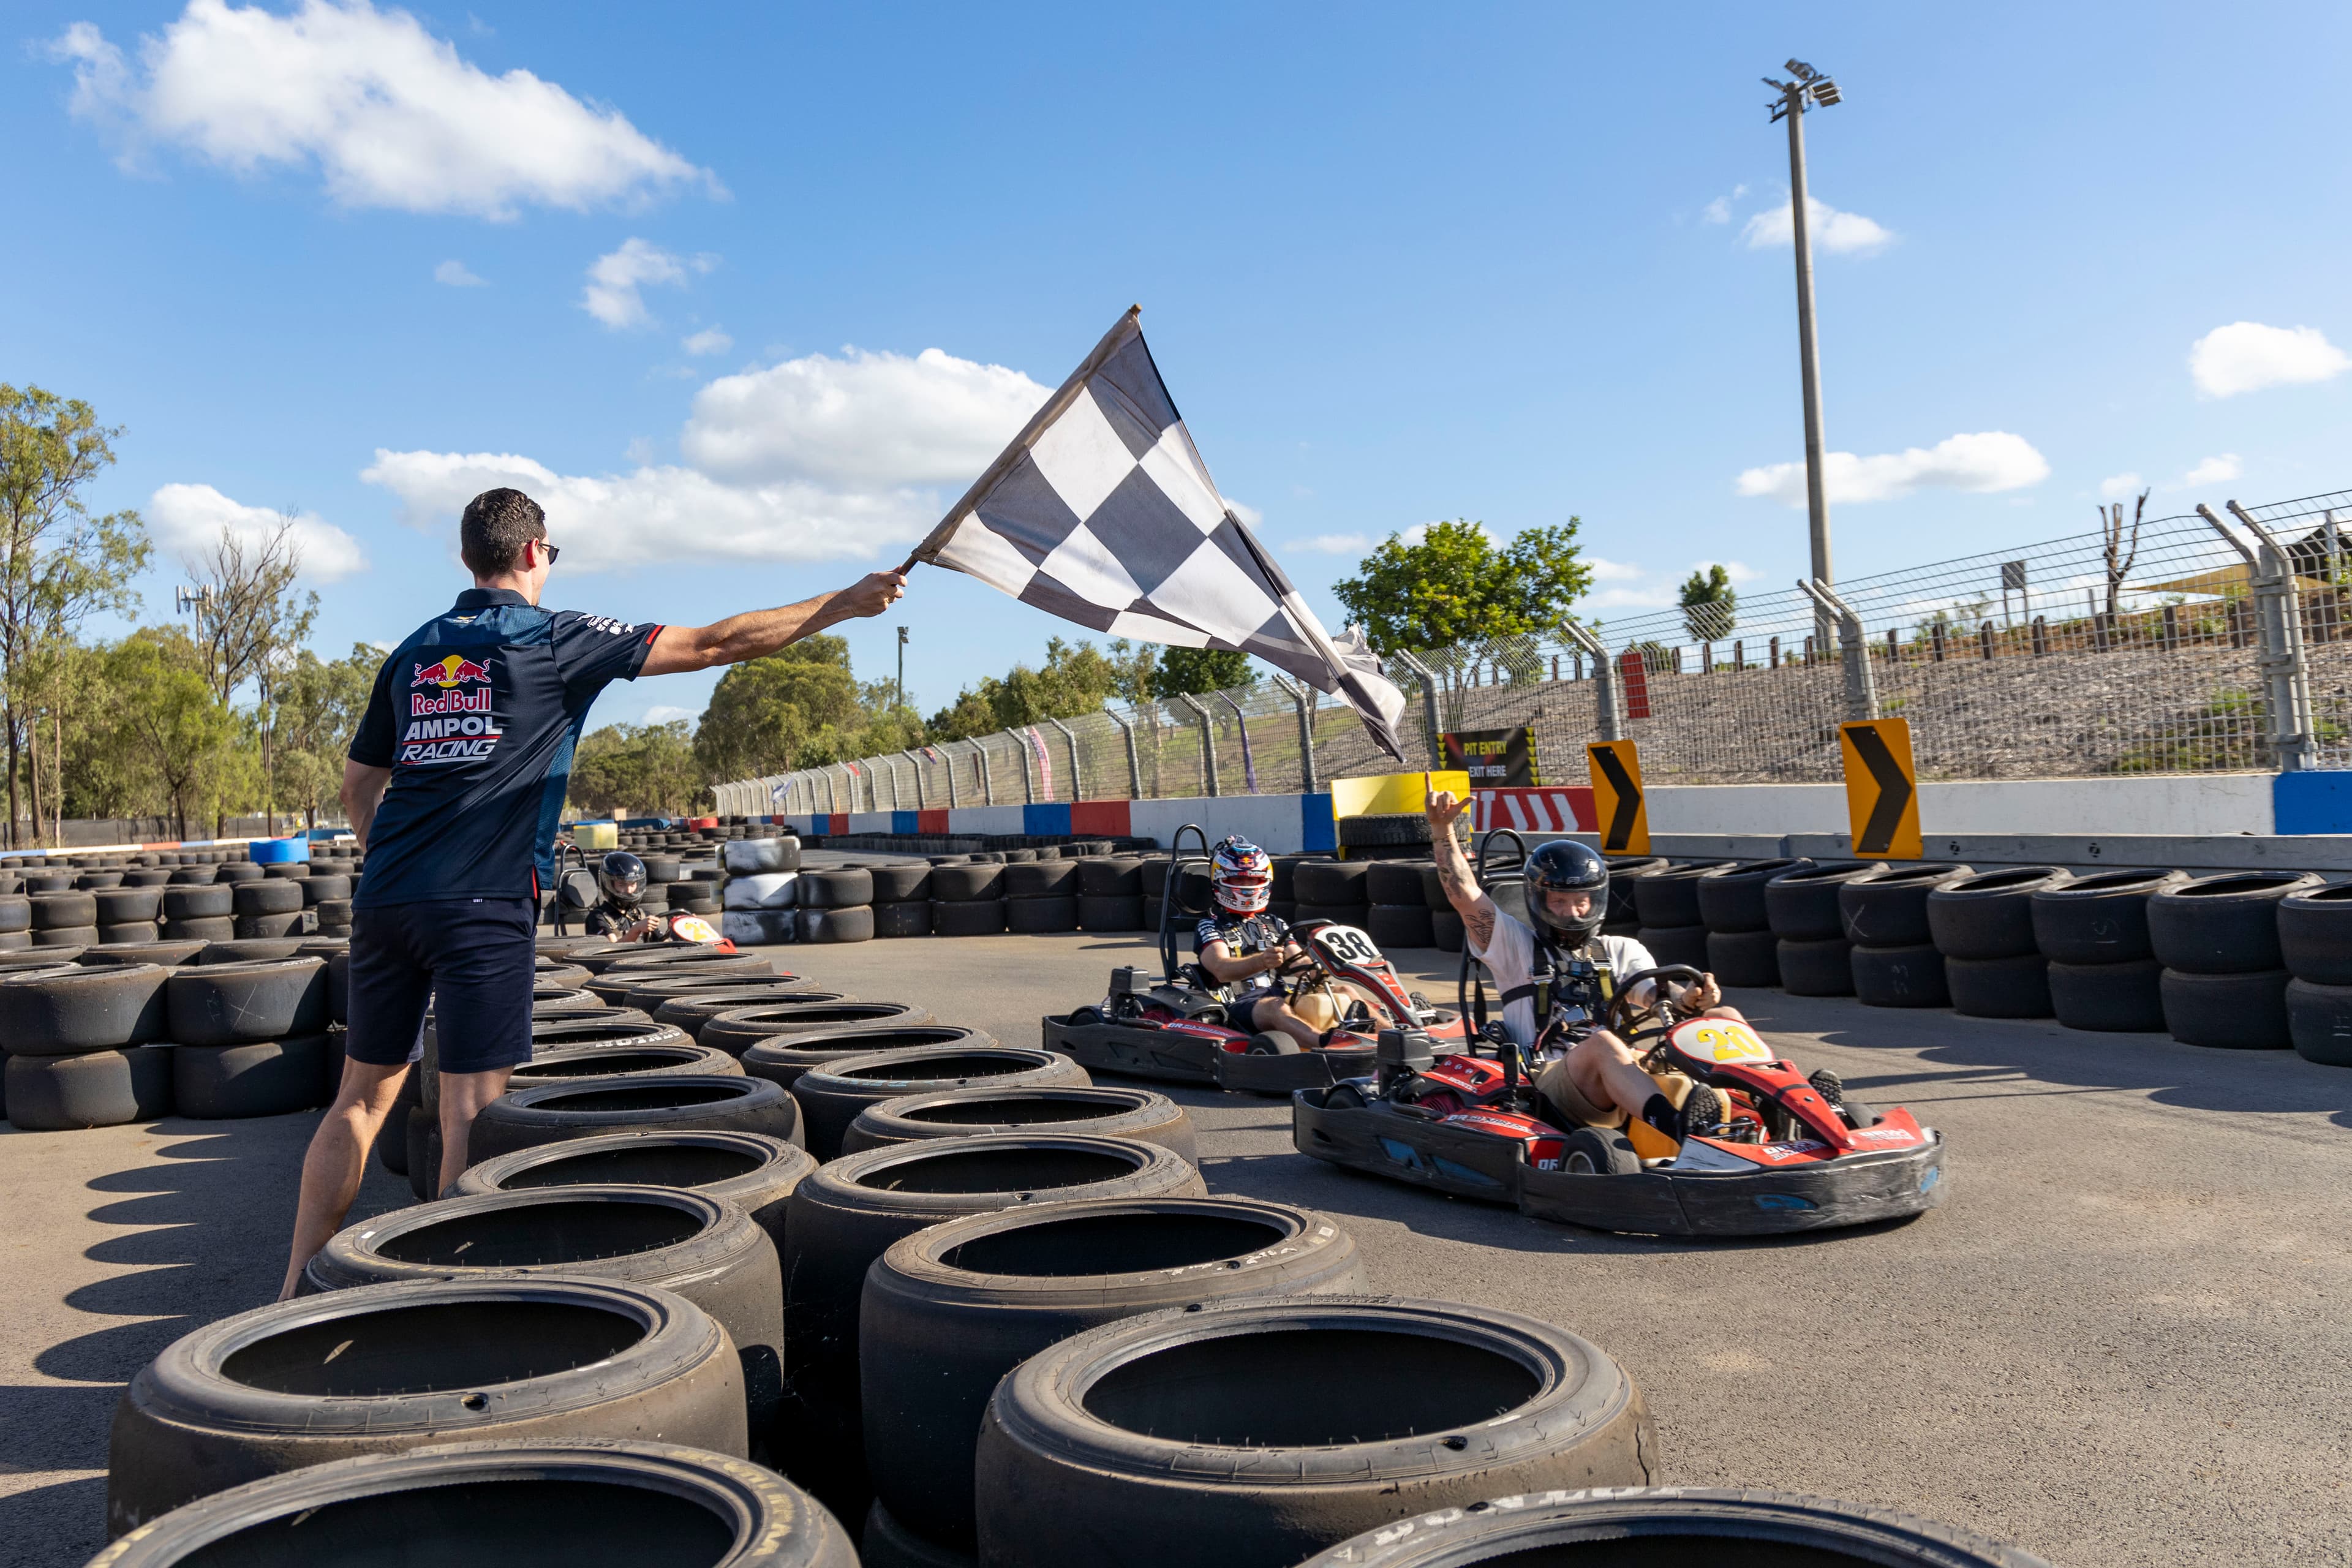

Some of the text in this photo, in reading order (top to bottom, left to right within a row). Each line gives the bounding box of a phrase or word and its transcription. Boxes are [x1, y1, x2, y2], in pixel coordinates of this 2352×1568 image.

[412, 687, 491, 716] Red Bull
[404, 716, 503, 741] AMPOL
[401, 739, 498, 761] RACING
[1464, 741, 1507, 755] PIT ENTRY
[1468, 765, 1507, 777] EXIT HERE
[1325, 932, 1376, 960] 38
[1697, 1026, 1765, 1061] 20
